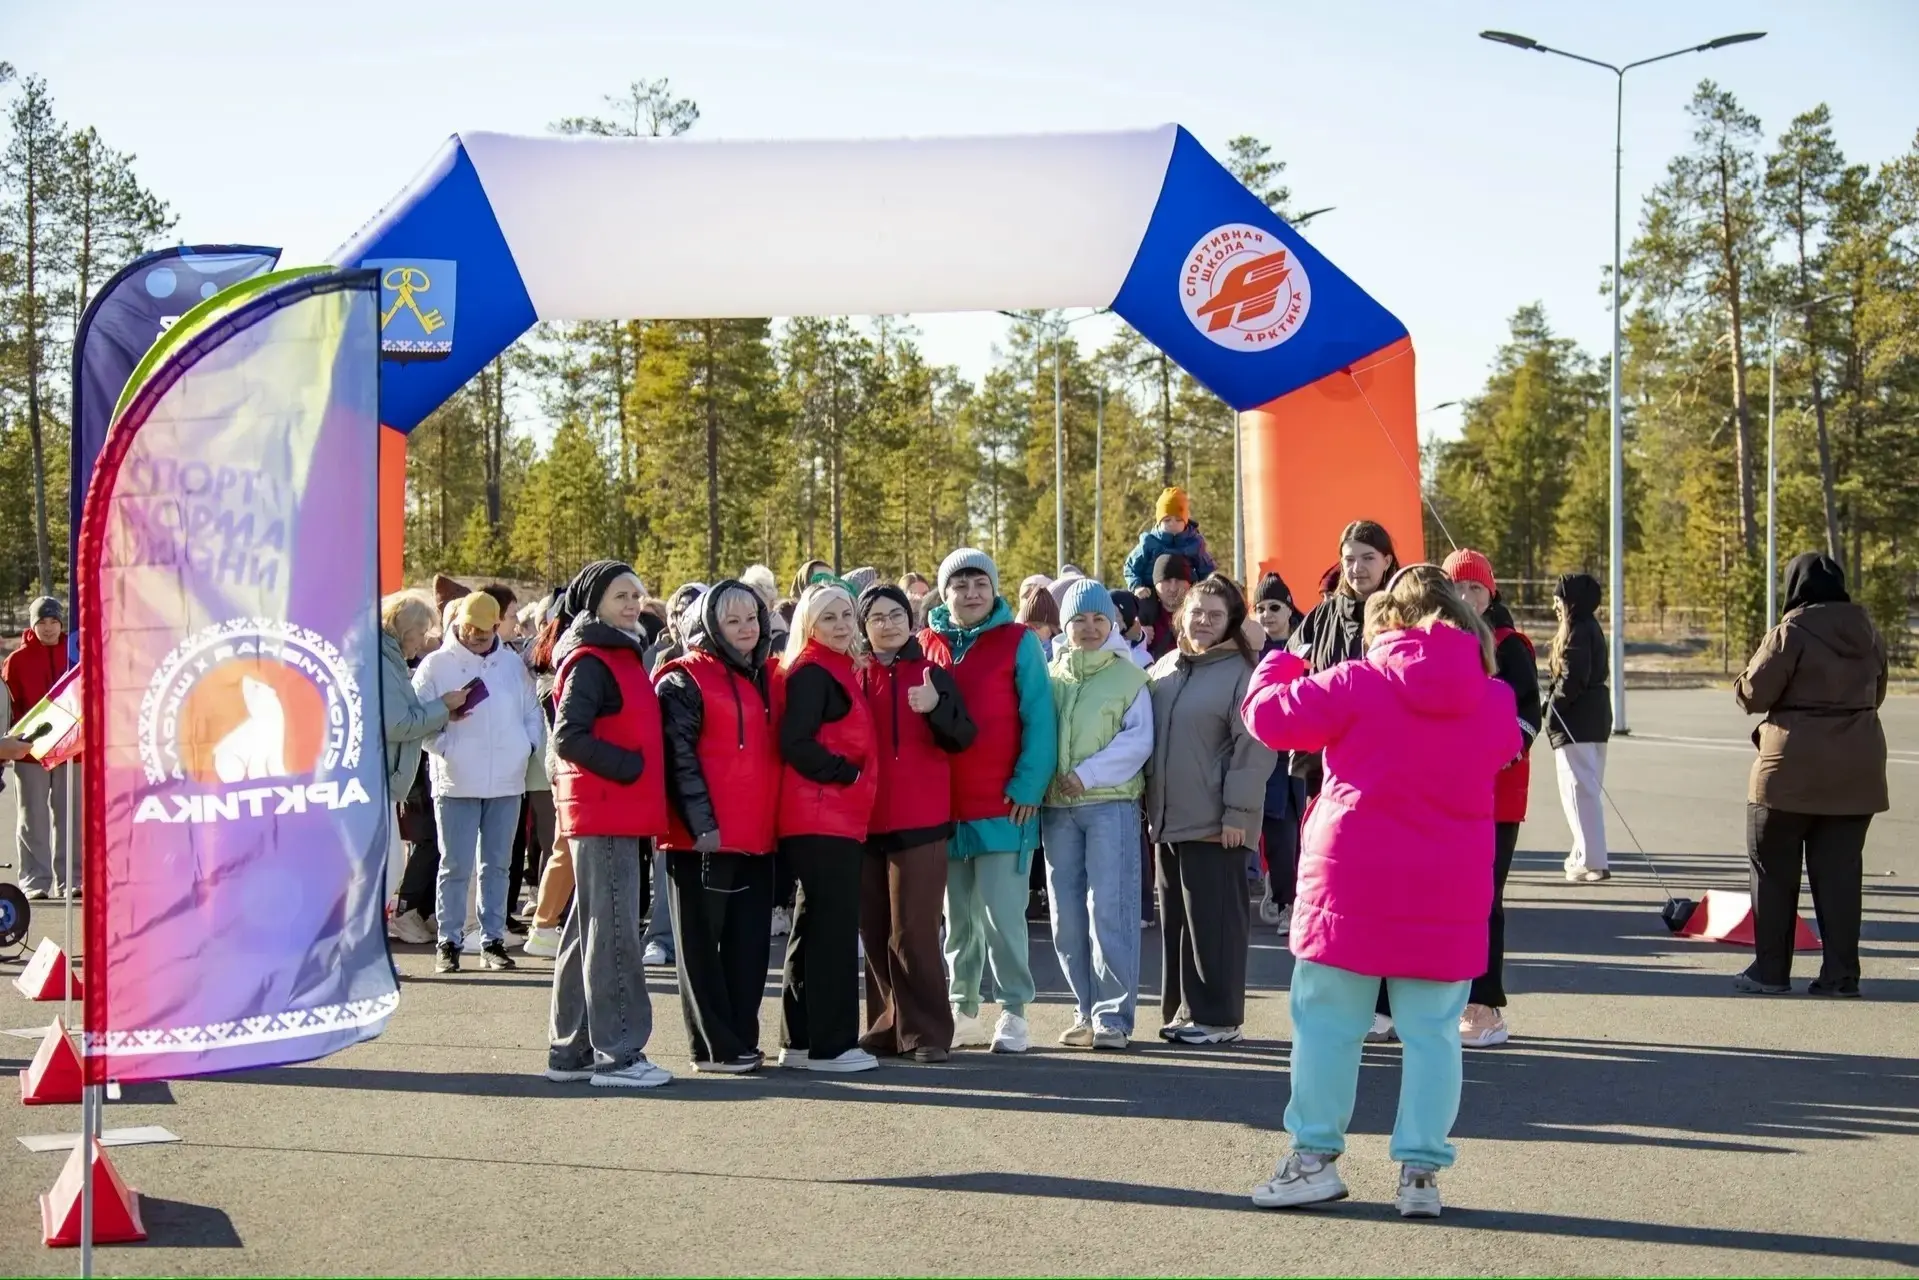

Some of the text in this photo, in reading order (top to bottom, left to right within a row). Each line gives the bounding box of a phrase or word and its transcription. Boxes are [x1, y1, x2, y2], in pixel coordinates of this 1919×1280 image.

[1187, 230, 1263, 297] СПОРТИВНАЯ
[1201, 241, 1244, 282] ШКОЛА
[1244, 292, 1302, 342] АРКТИКА
